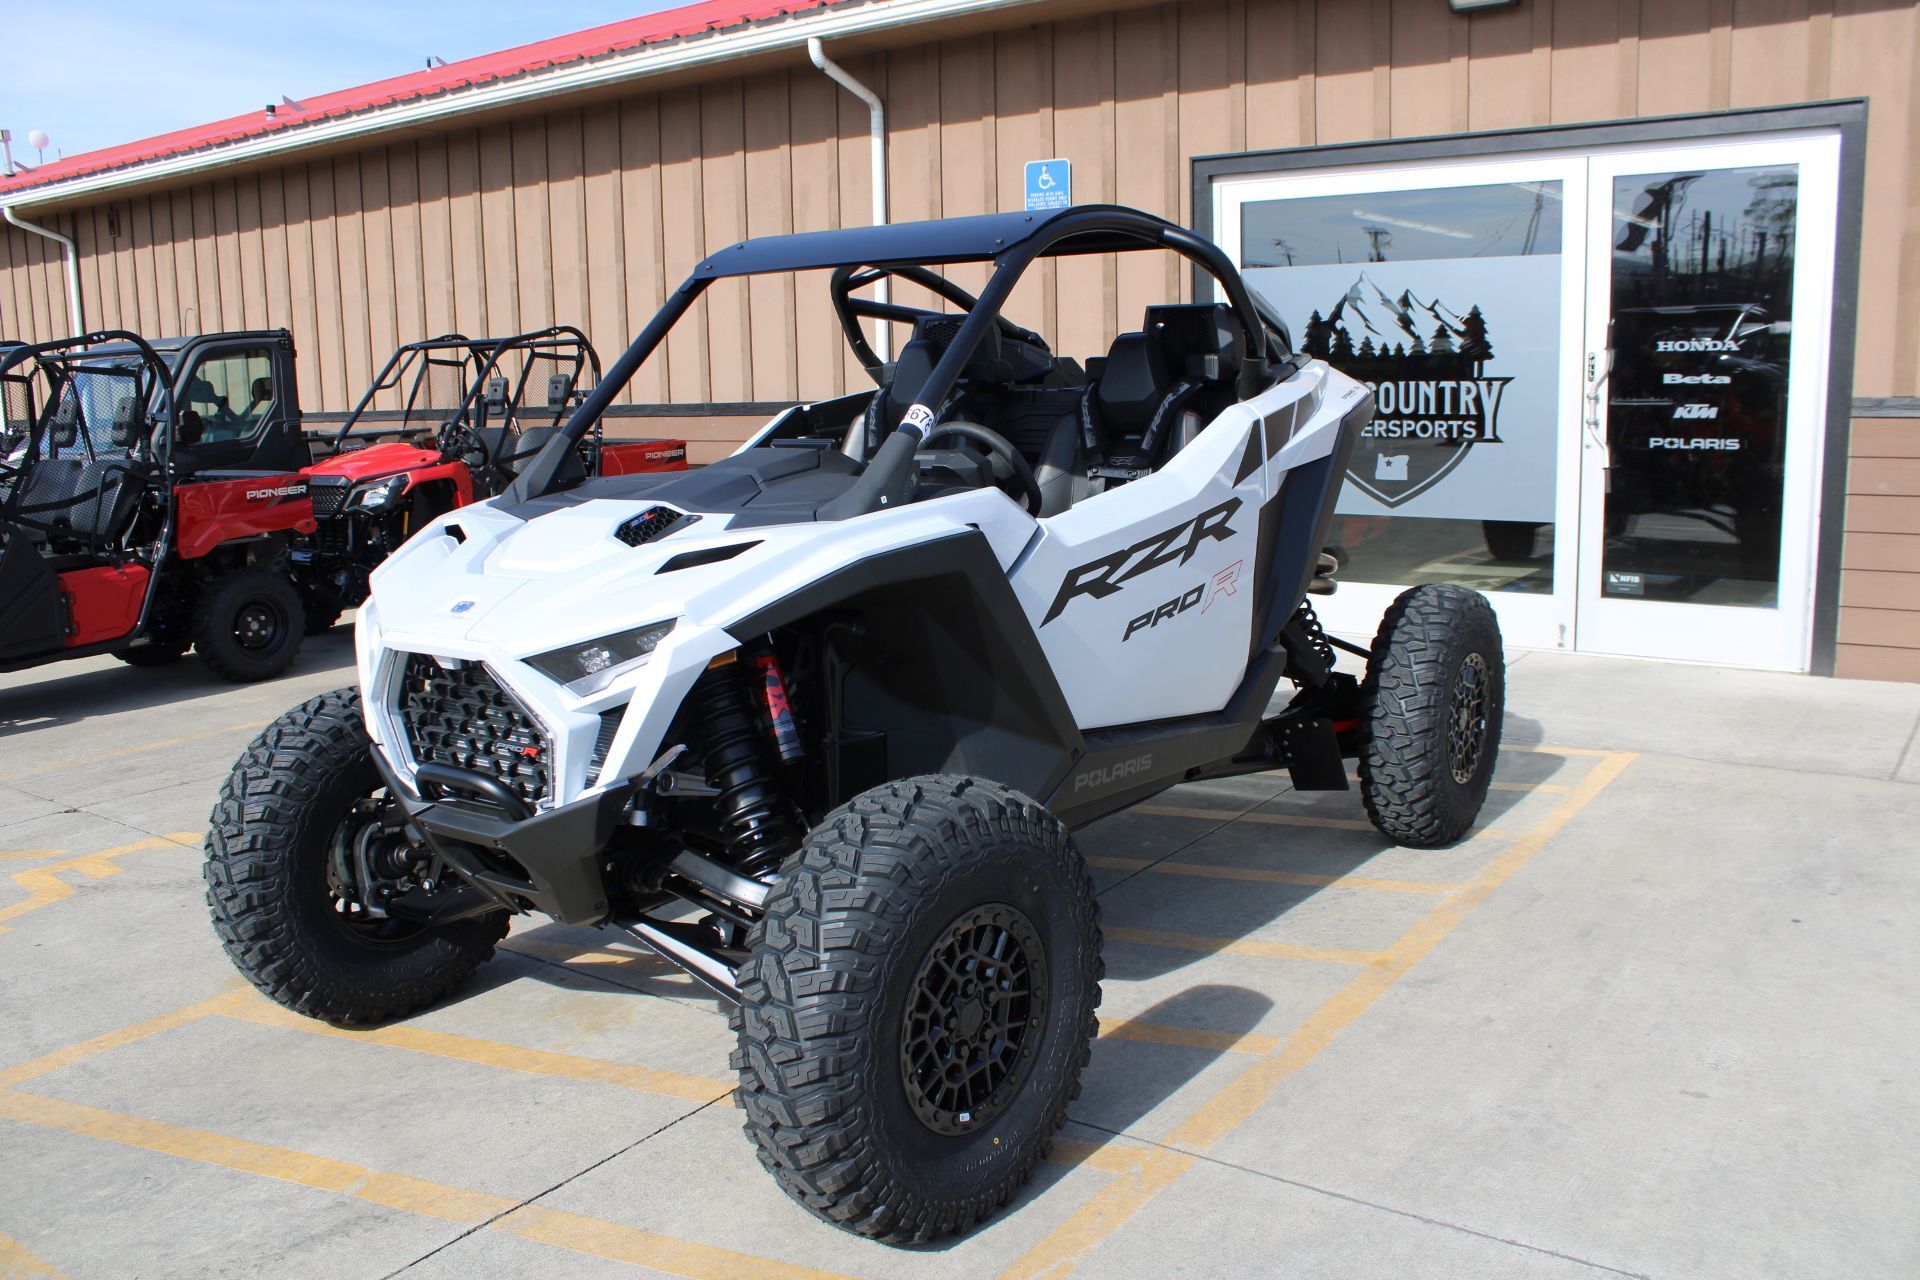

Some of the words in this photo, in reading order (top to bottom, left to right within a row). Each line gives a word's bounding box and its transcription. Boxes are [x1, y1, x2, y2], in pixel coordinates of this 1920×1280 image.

[1656, 340, 1740, 352] HONDA
[1663, 373, 1731, 384] Beta
[1672, 404, 1719, 418] KTM
[907, 408, 932, 432] 678
[1649, 438, 1740, 450] POLARIS
[645, 448, 684, 460] PIONEER
[246, 485, 307, 500] PIONEER
[1039, 496, 1244, 629] RZR
[1122, 582, 1206, 643] PRO
[1201, 559, 1244, 615] R
[1074, 753, 1152, 793] POLARIS
